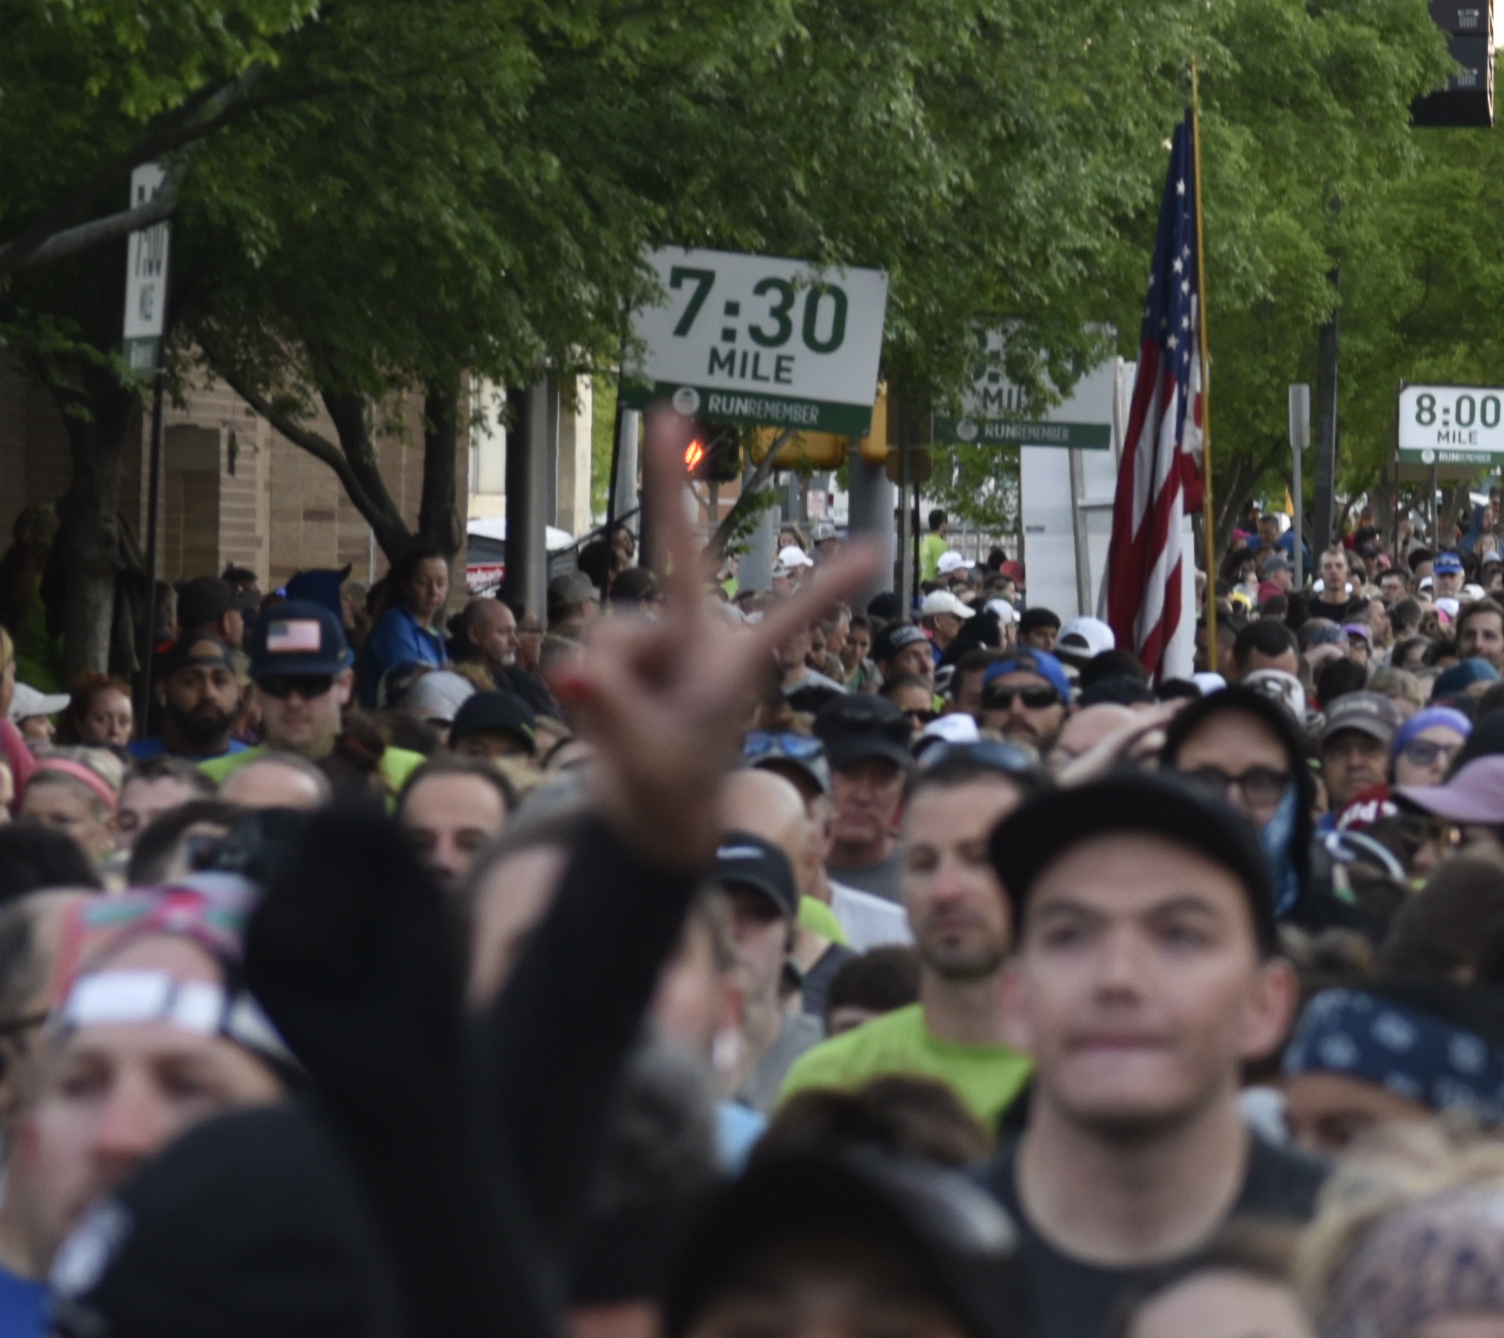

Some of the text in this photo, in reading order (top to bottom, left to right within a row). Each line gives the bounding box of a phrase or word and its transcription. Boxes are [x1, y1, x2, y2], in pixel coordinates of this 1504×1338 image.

[669, 265, 849, 355] 7:30
[707, 345, 796, 385] MILE
[707, 393, 820, 425] RUNREMEMBER
[1414, 392, 1501, 429] 8:00
[1437, 430, 1478, 446] MILE
